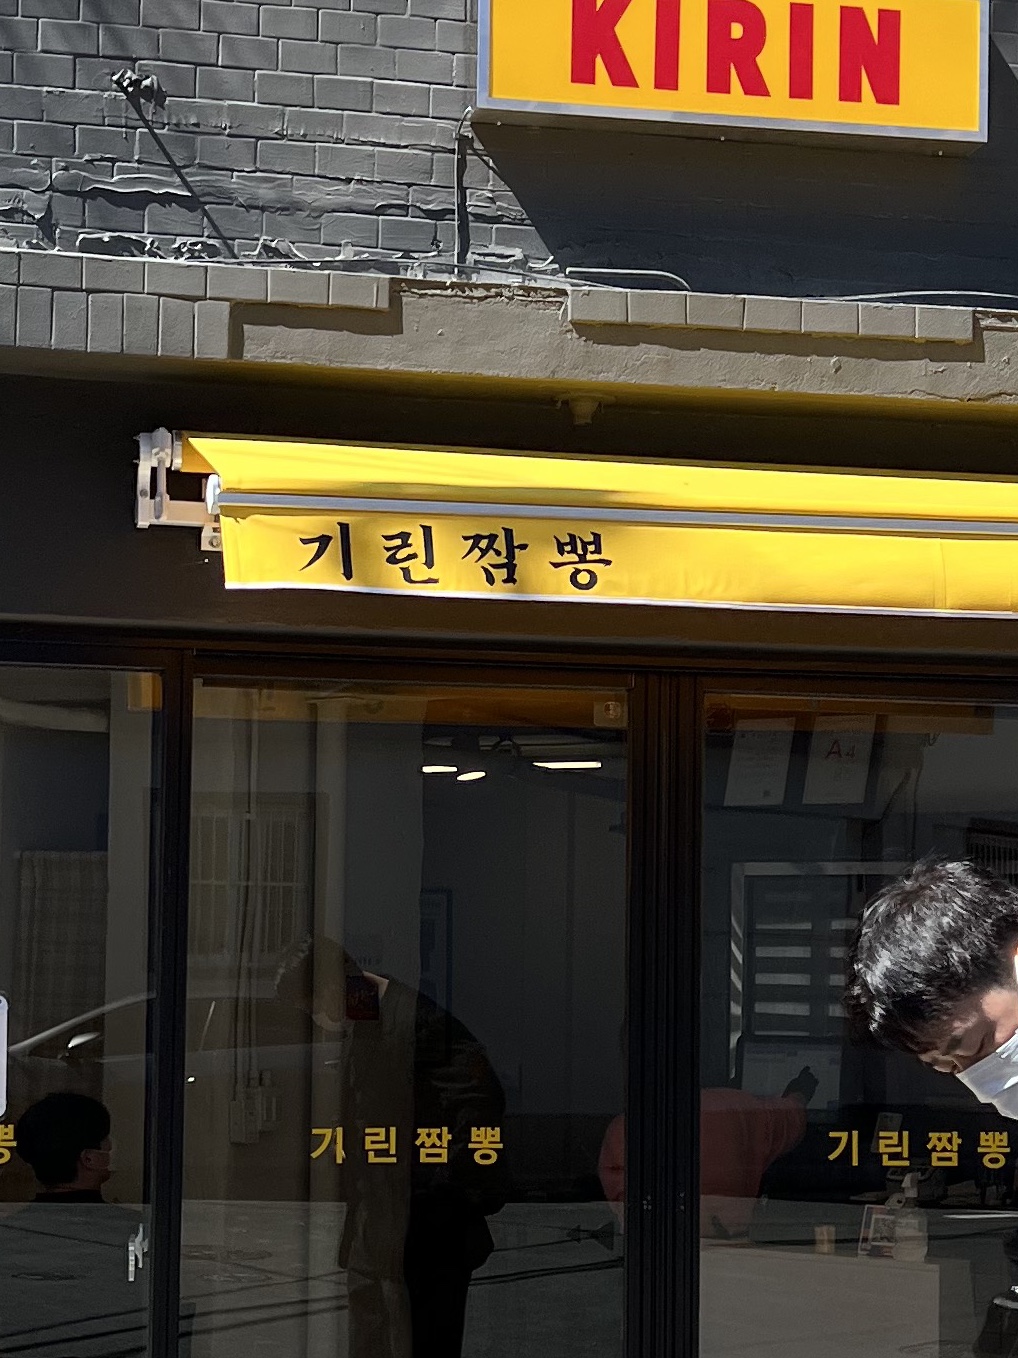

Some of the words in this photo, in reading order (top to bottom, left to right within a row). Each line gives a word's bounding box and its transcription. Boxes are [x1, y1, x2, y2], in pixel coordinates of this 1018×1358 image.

[570, 0, 901, 106] KIRIN
[299, 522, 613, 591] 기린짬뽕
[310, 1125, 504, 1166] 기린짬뽕
[828, 1130, 1011, 1169] 기린짬뽕
